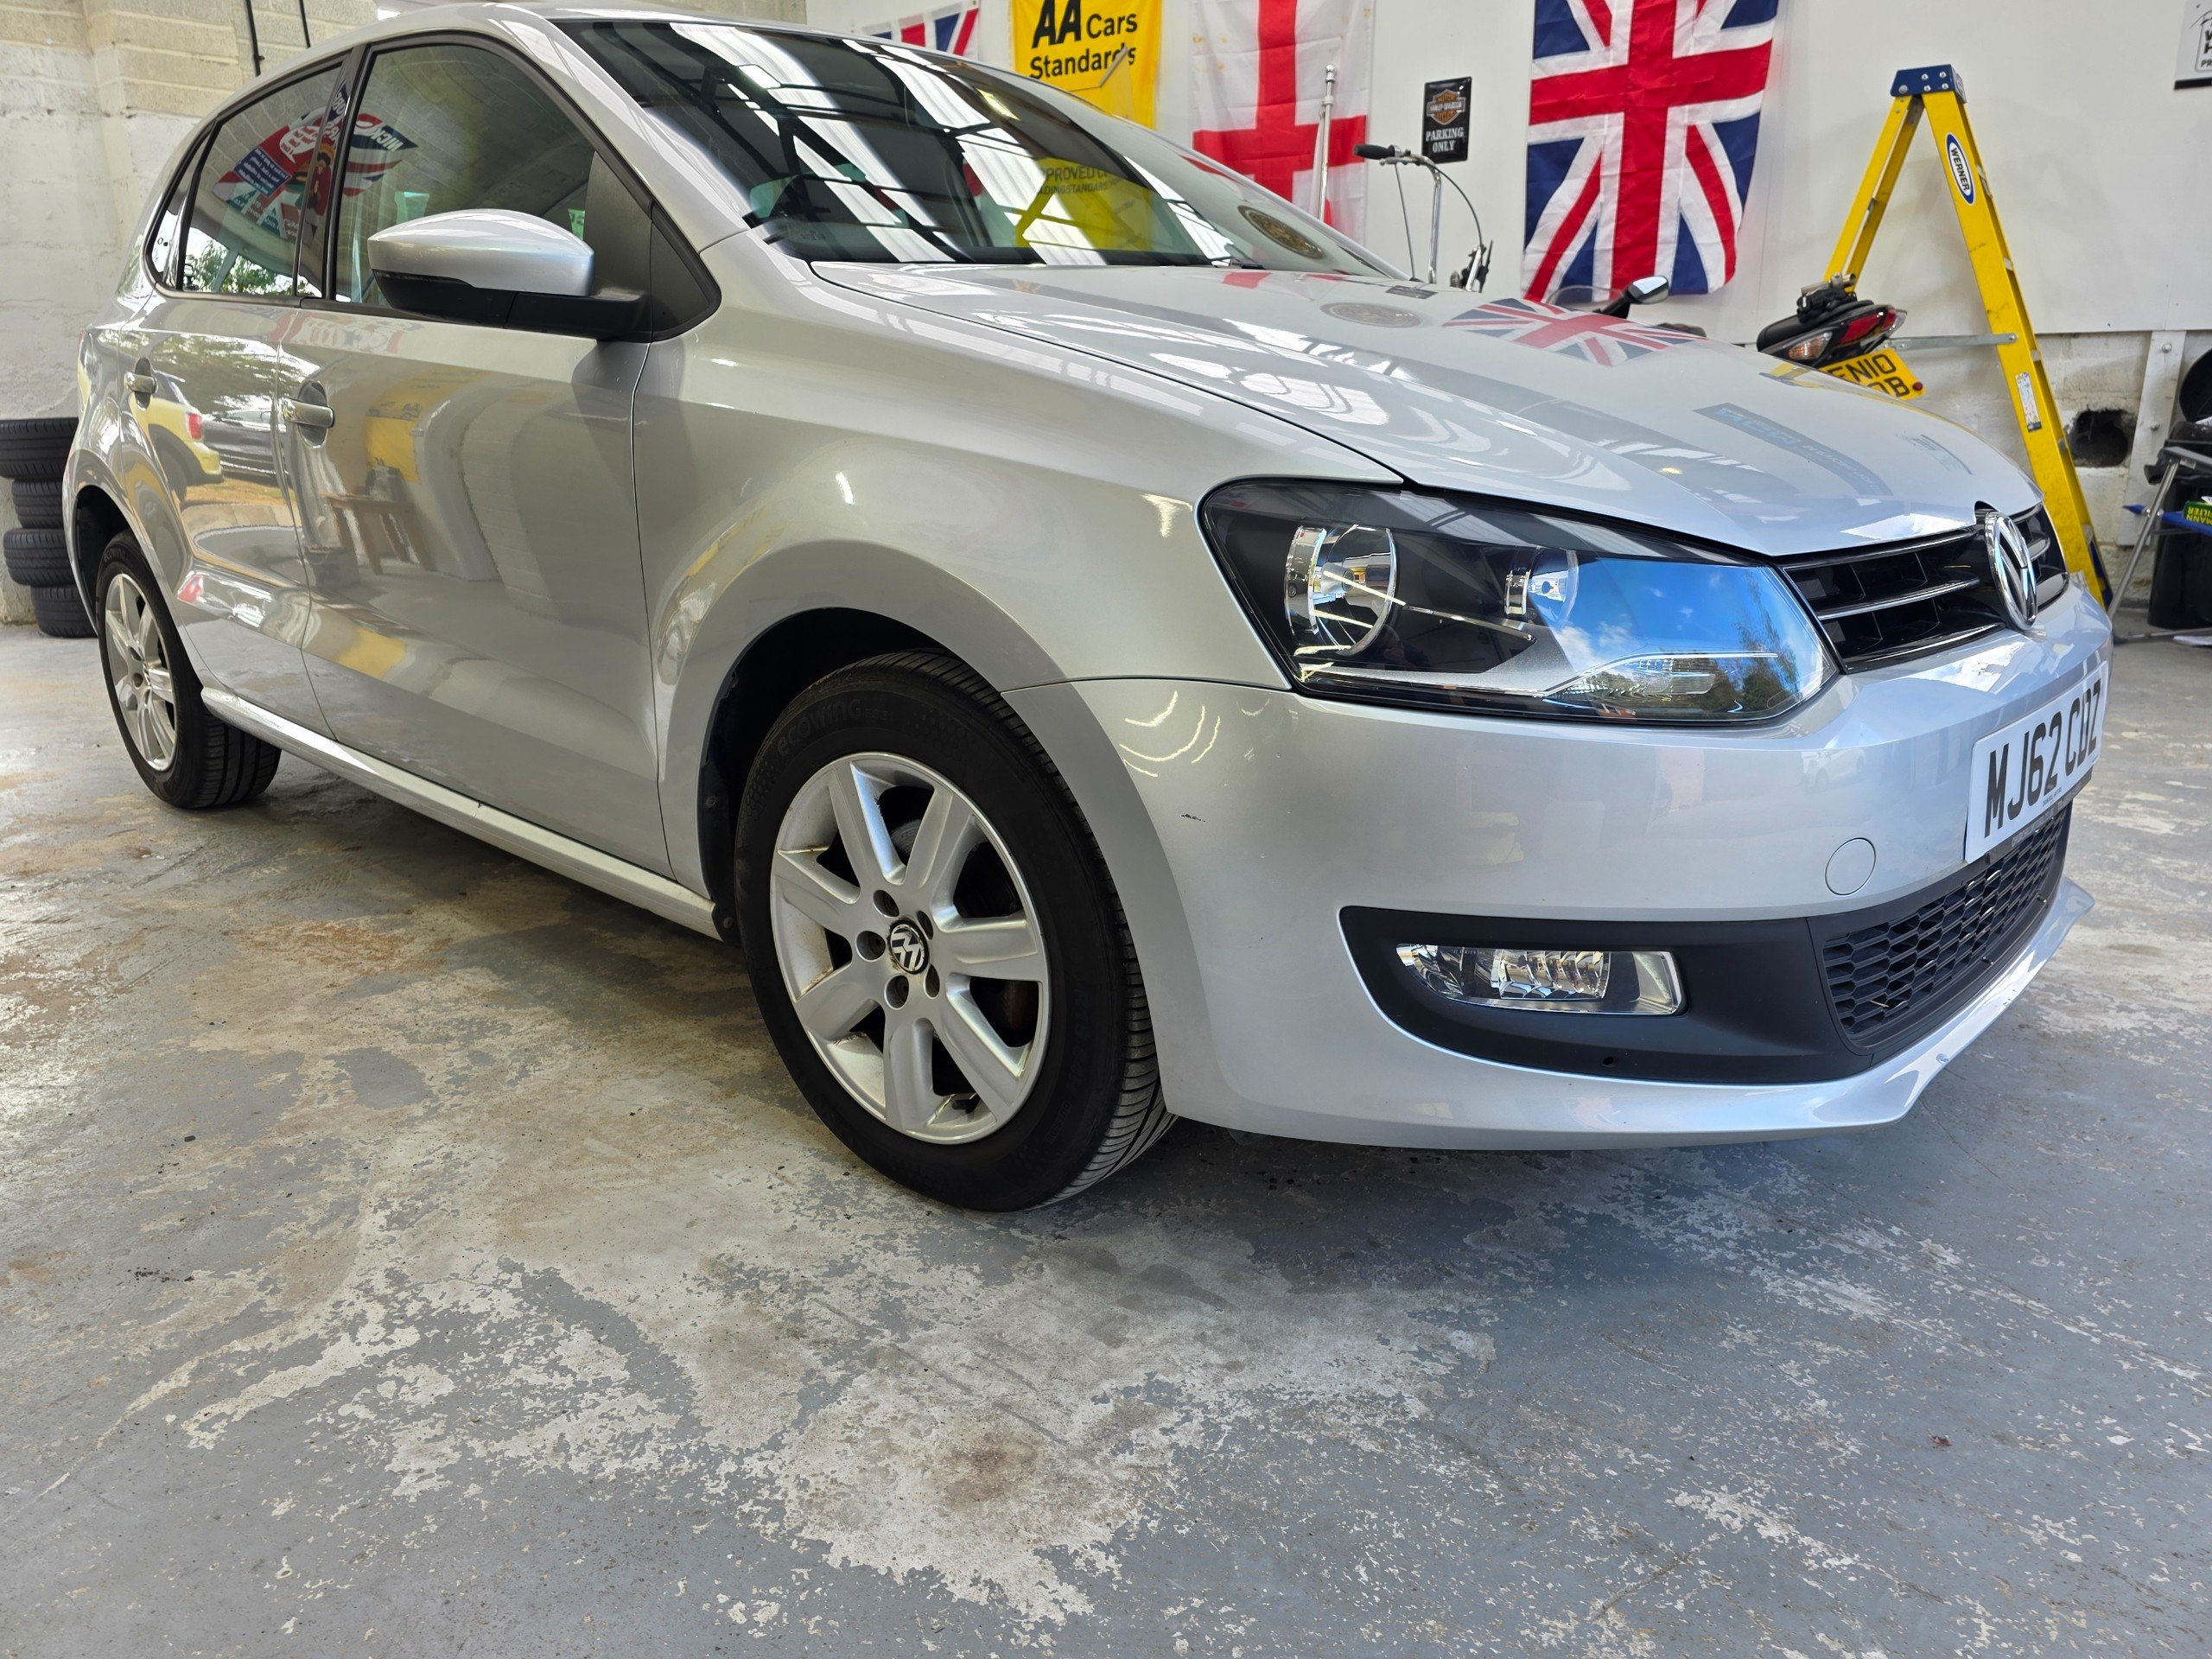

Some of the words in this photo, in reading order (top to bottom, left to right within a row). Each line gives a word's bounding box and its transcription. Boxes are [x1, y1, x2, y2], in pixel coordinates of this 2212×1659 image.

[1032, 0, 1081, 48] AA
[1086, 13, 1138, 39] Cars
[1426, 127, 1465, 142] PARKING
[1433, 140, 1457, 153] ONLY
[1950, 147, 1971, 191] WERNER
[1984, 711, 2063, 838] MJ62
[2065, 678, 2101, 778] CDZ
